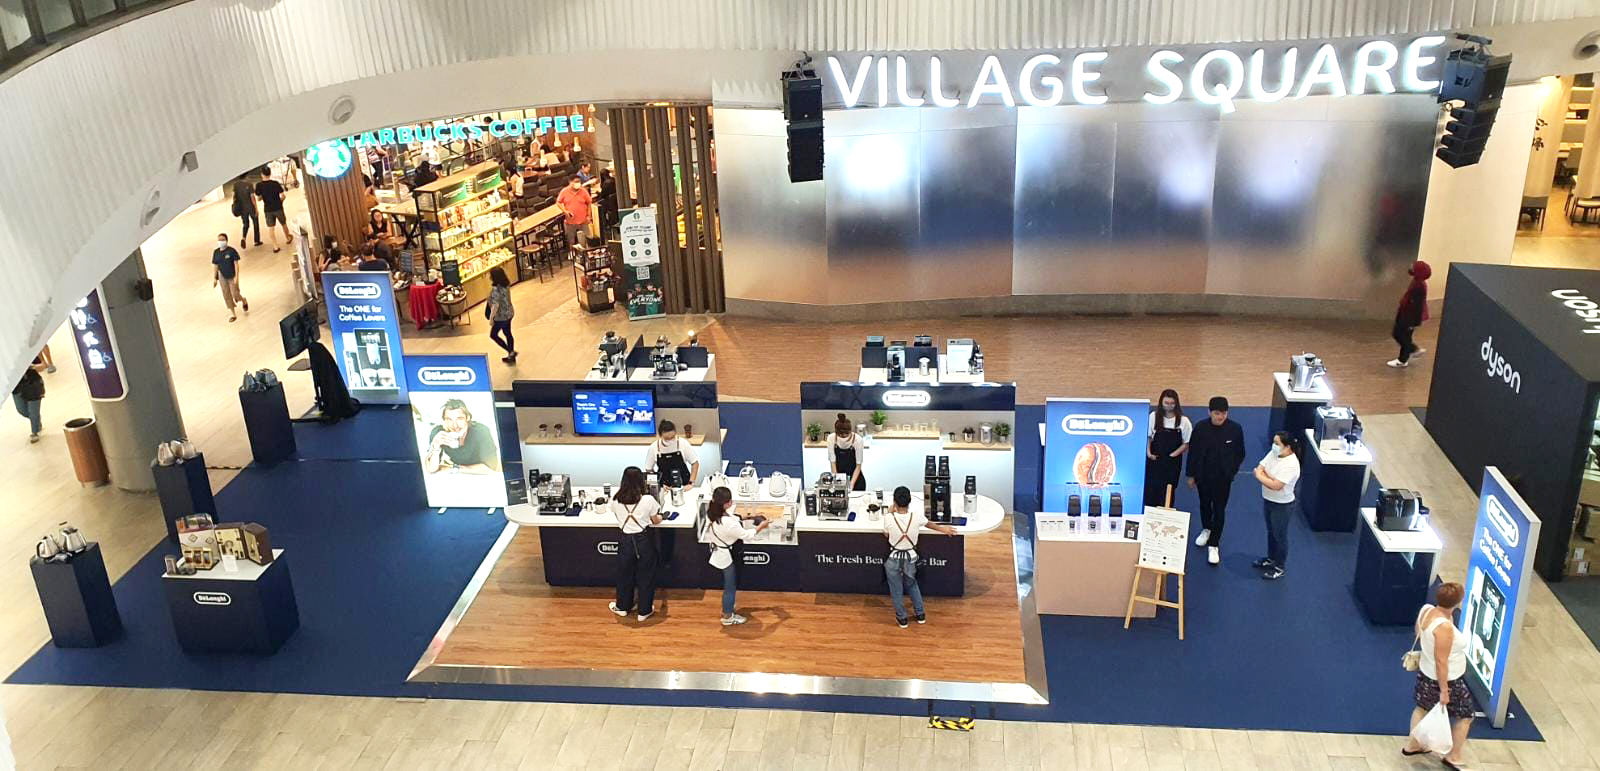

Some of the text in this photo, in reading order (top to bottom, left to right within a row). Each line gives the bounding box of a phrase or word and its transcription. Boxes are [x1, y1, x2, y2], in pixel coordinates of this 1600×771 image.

[827, 35, 1446, 113] VILLAGE SQUARE
[490, 115, 585, 138] COFFEE
[339, 305, 382, 313] The ONE for
[339, 314, 386, 322] Coffee Lovers
[1481, 336, 1520, 394] dyson
[815, 554, 834, 564] The
[836, 554, 863, 565] Fresh
[866, 555, 883, 565] Bea
[929, 558, 947, 566] Bar
[1479, 538, 1511, 587] Coffee Lovers
[1483, 527, 1513, 571] The ONE for
